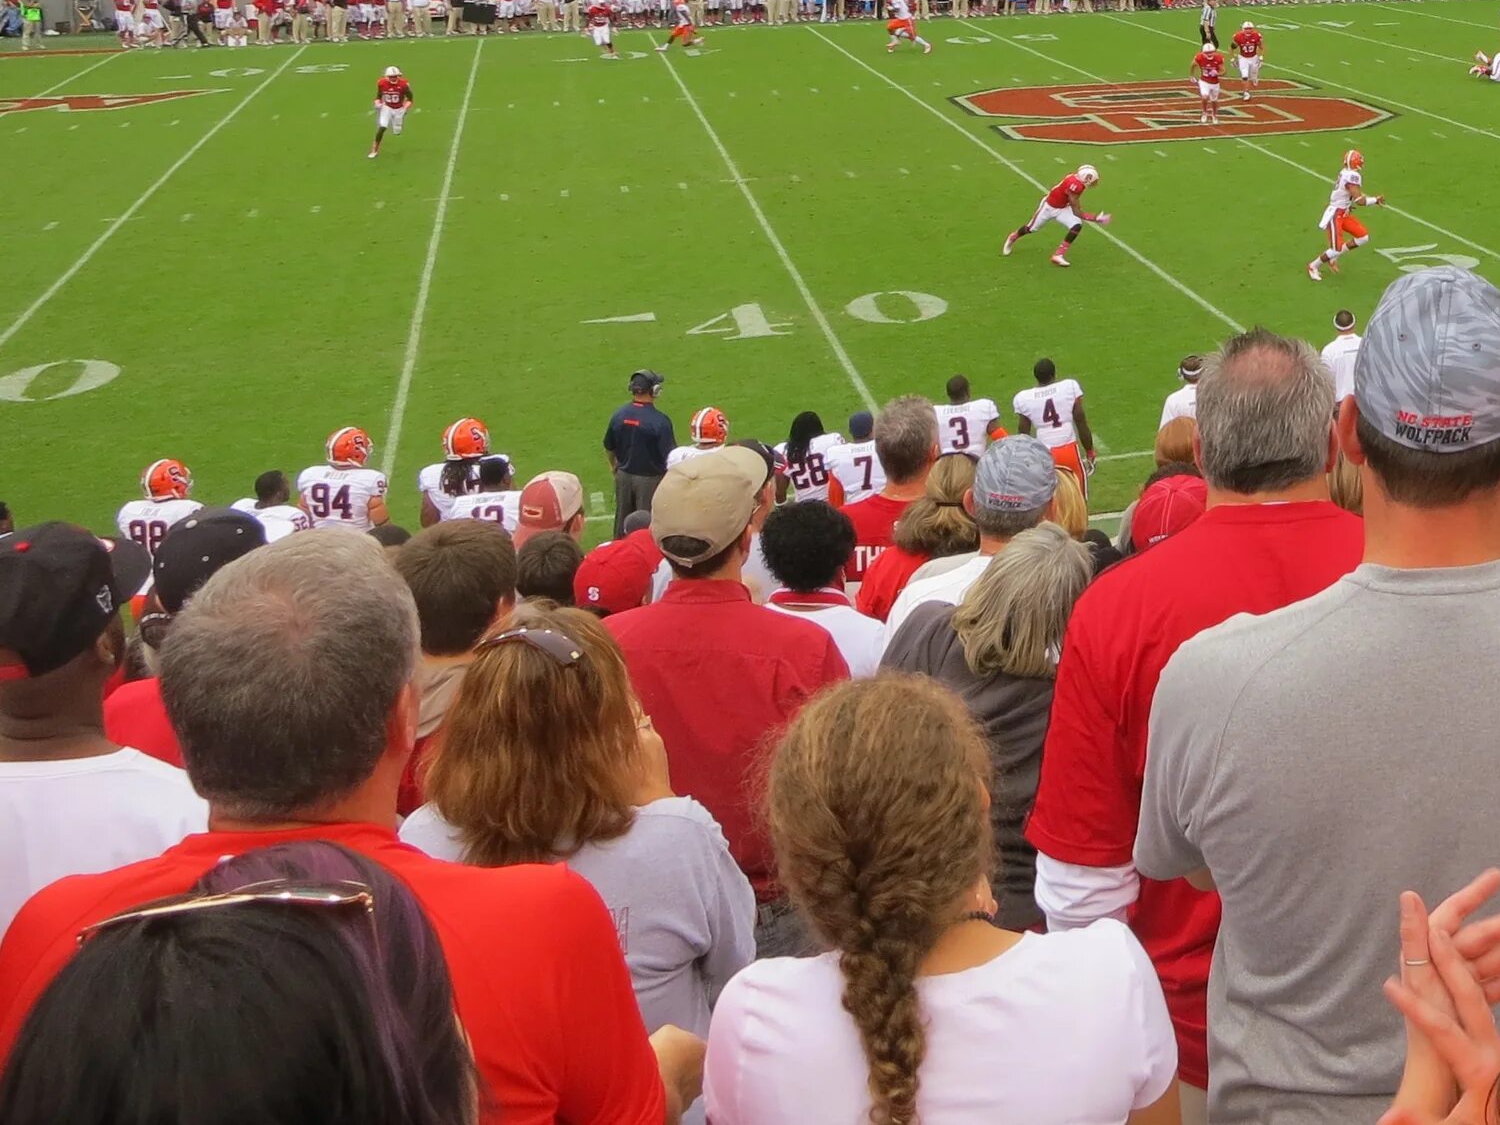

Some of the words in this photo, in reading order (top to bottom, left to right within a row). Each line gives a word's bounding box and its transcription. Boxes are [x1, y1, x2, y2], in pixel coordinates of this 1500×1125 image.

[1042, 398, 1062, 429] 4
[1397, 410, 1418, 424] NC
[1420, 411, 1473, 428] STATE
[949, 416, 970, 450] 3
[1395, 424, 1473, 445] WOLFPACK
[790, 452, 829, 490] 28
[853, 455, 874, 491] 7
[310, 483, 353, 520] 94
